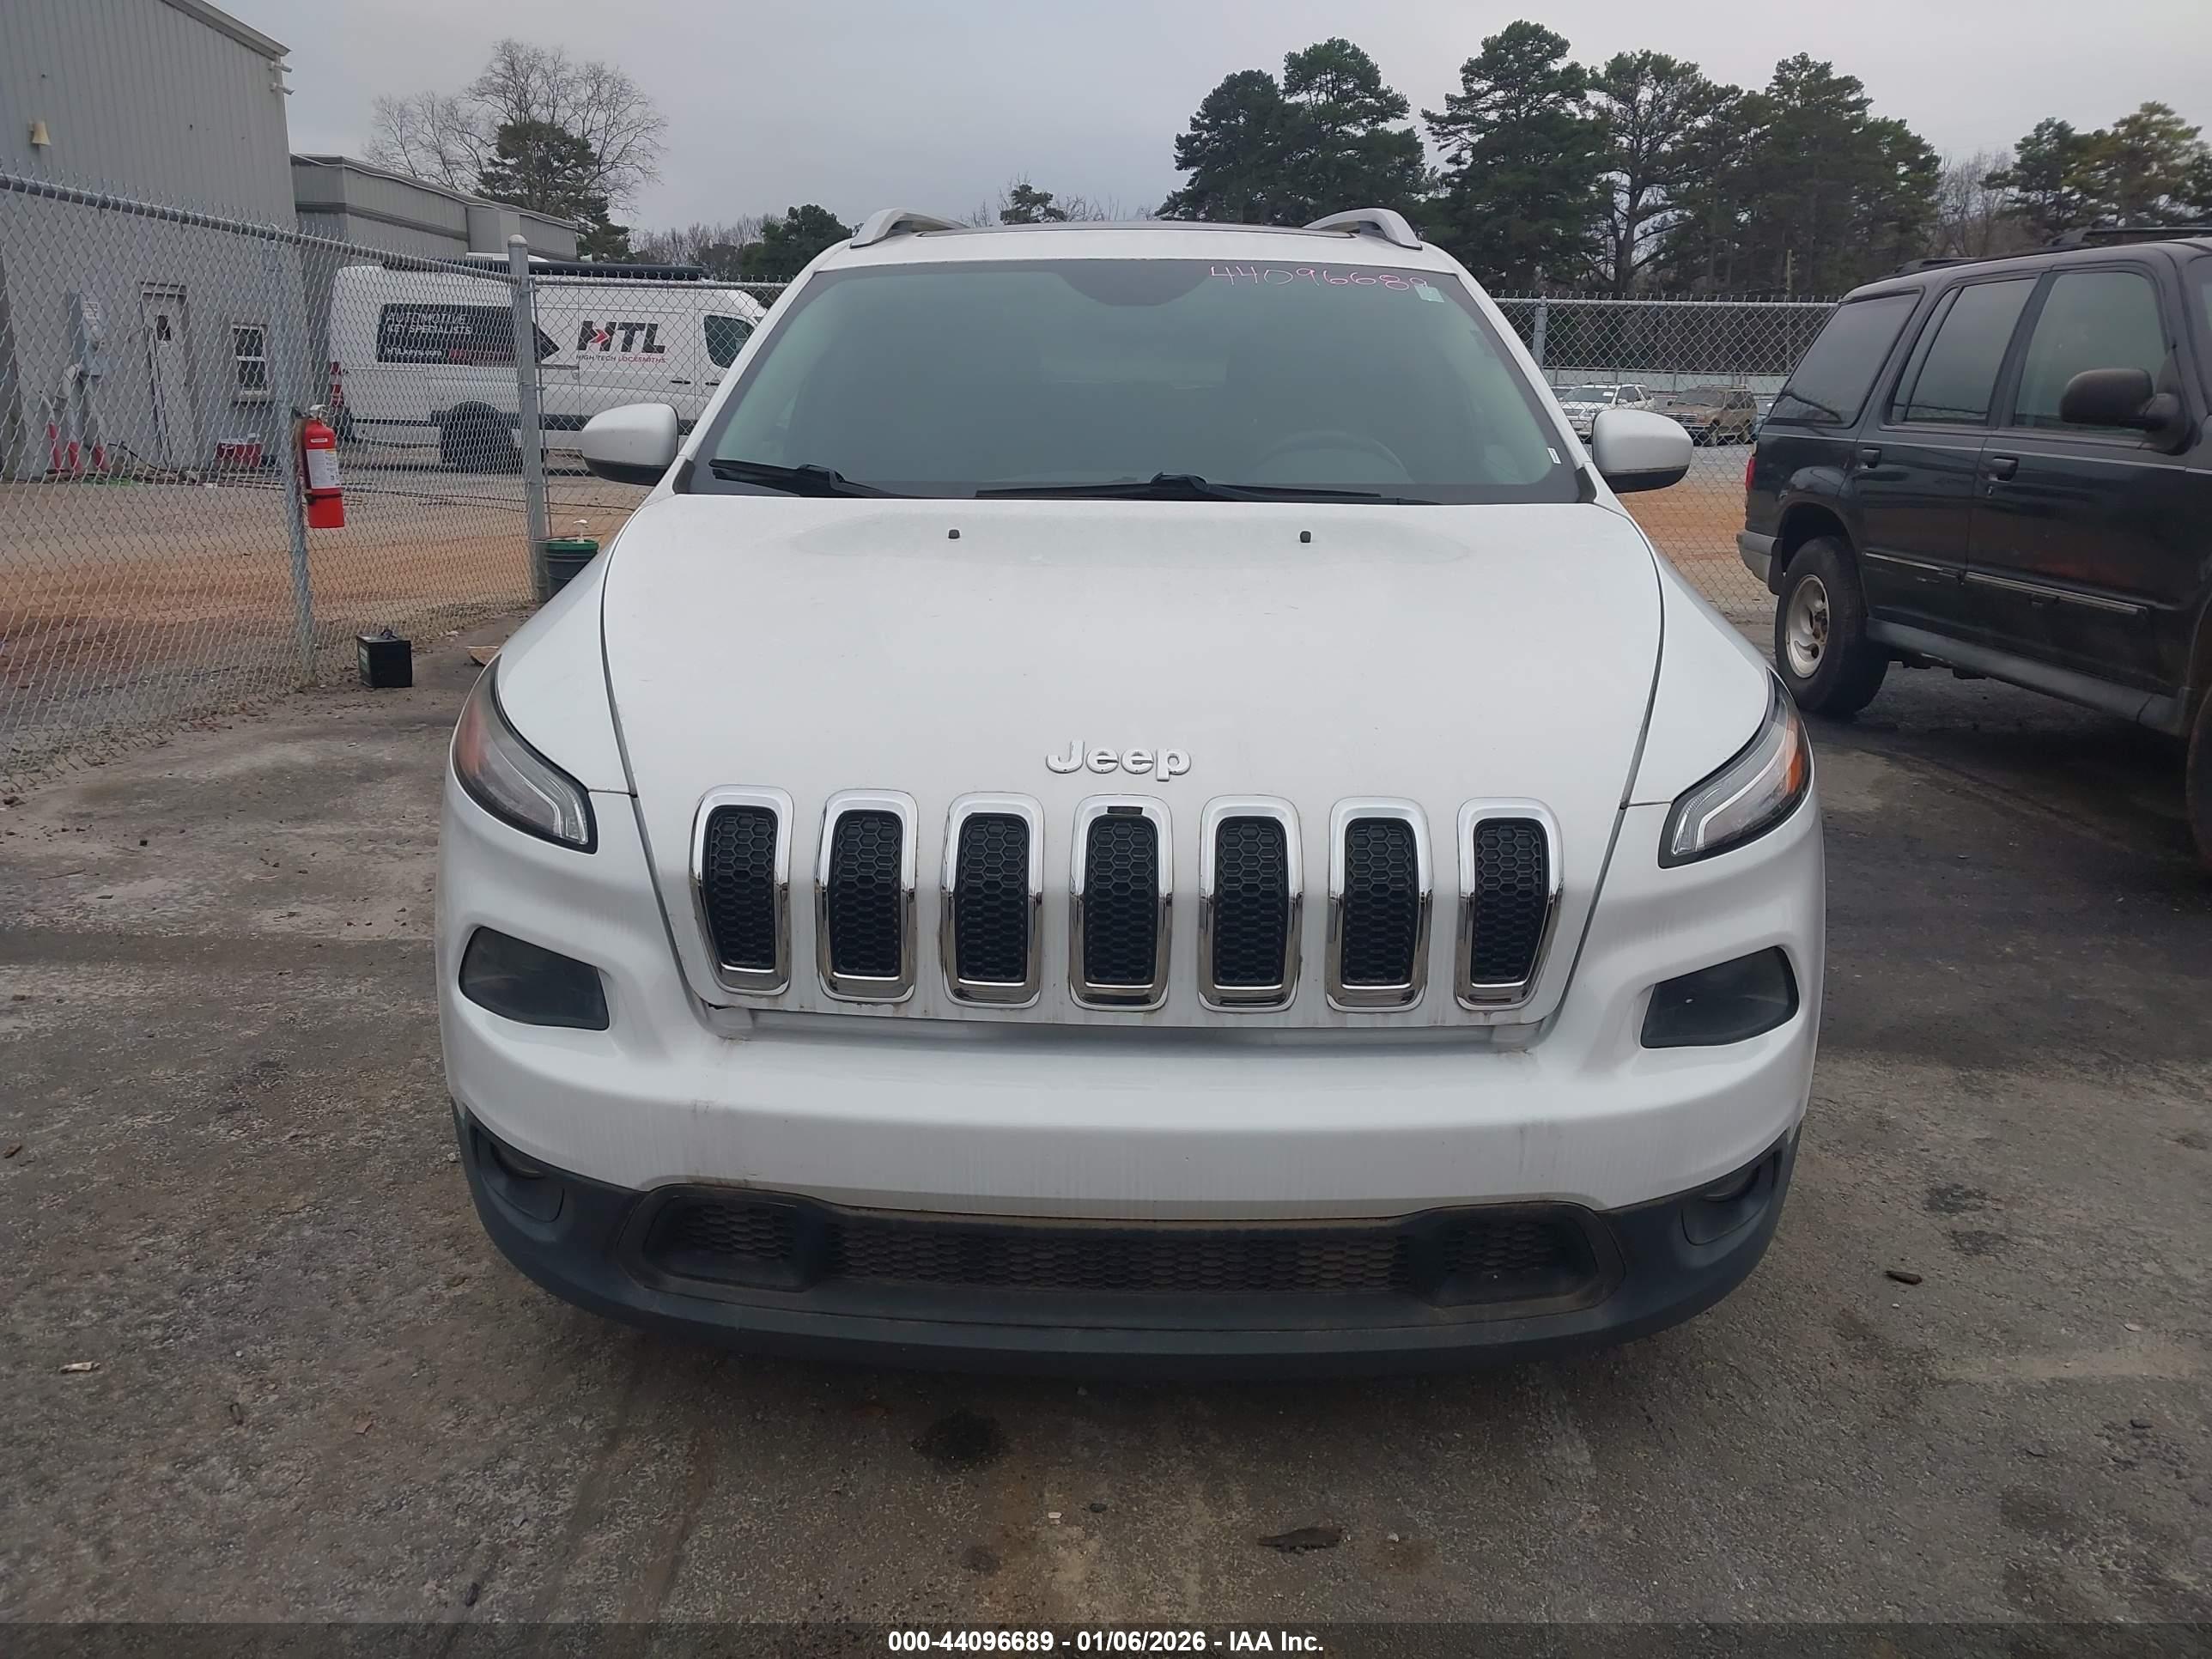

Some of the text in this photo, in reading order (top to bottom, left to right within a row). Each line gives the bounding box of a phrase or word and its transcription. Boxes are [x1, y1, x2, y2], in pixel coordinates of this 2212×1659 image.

[1210, 265, 1429, 290] 44096689
[386, 313, 467, 325] AUTOMOTIVE
[386, 324, 472, 335] KEY SPECIALISTS
[577, 320, 665, 354] HTL
[1046, 740, 1192, 782] Jeep
